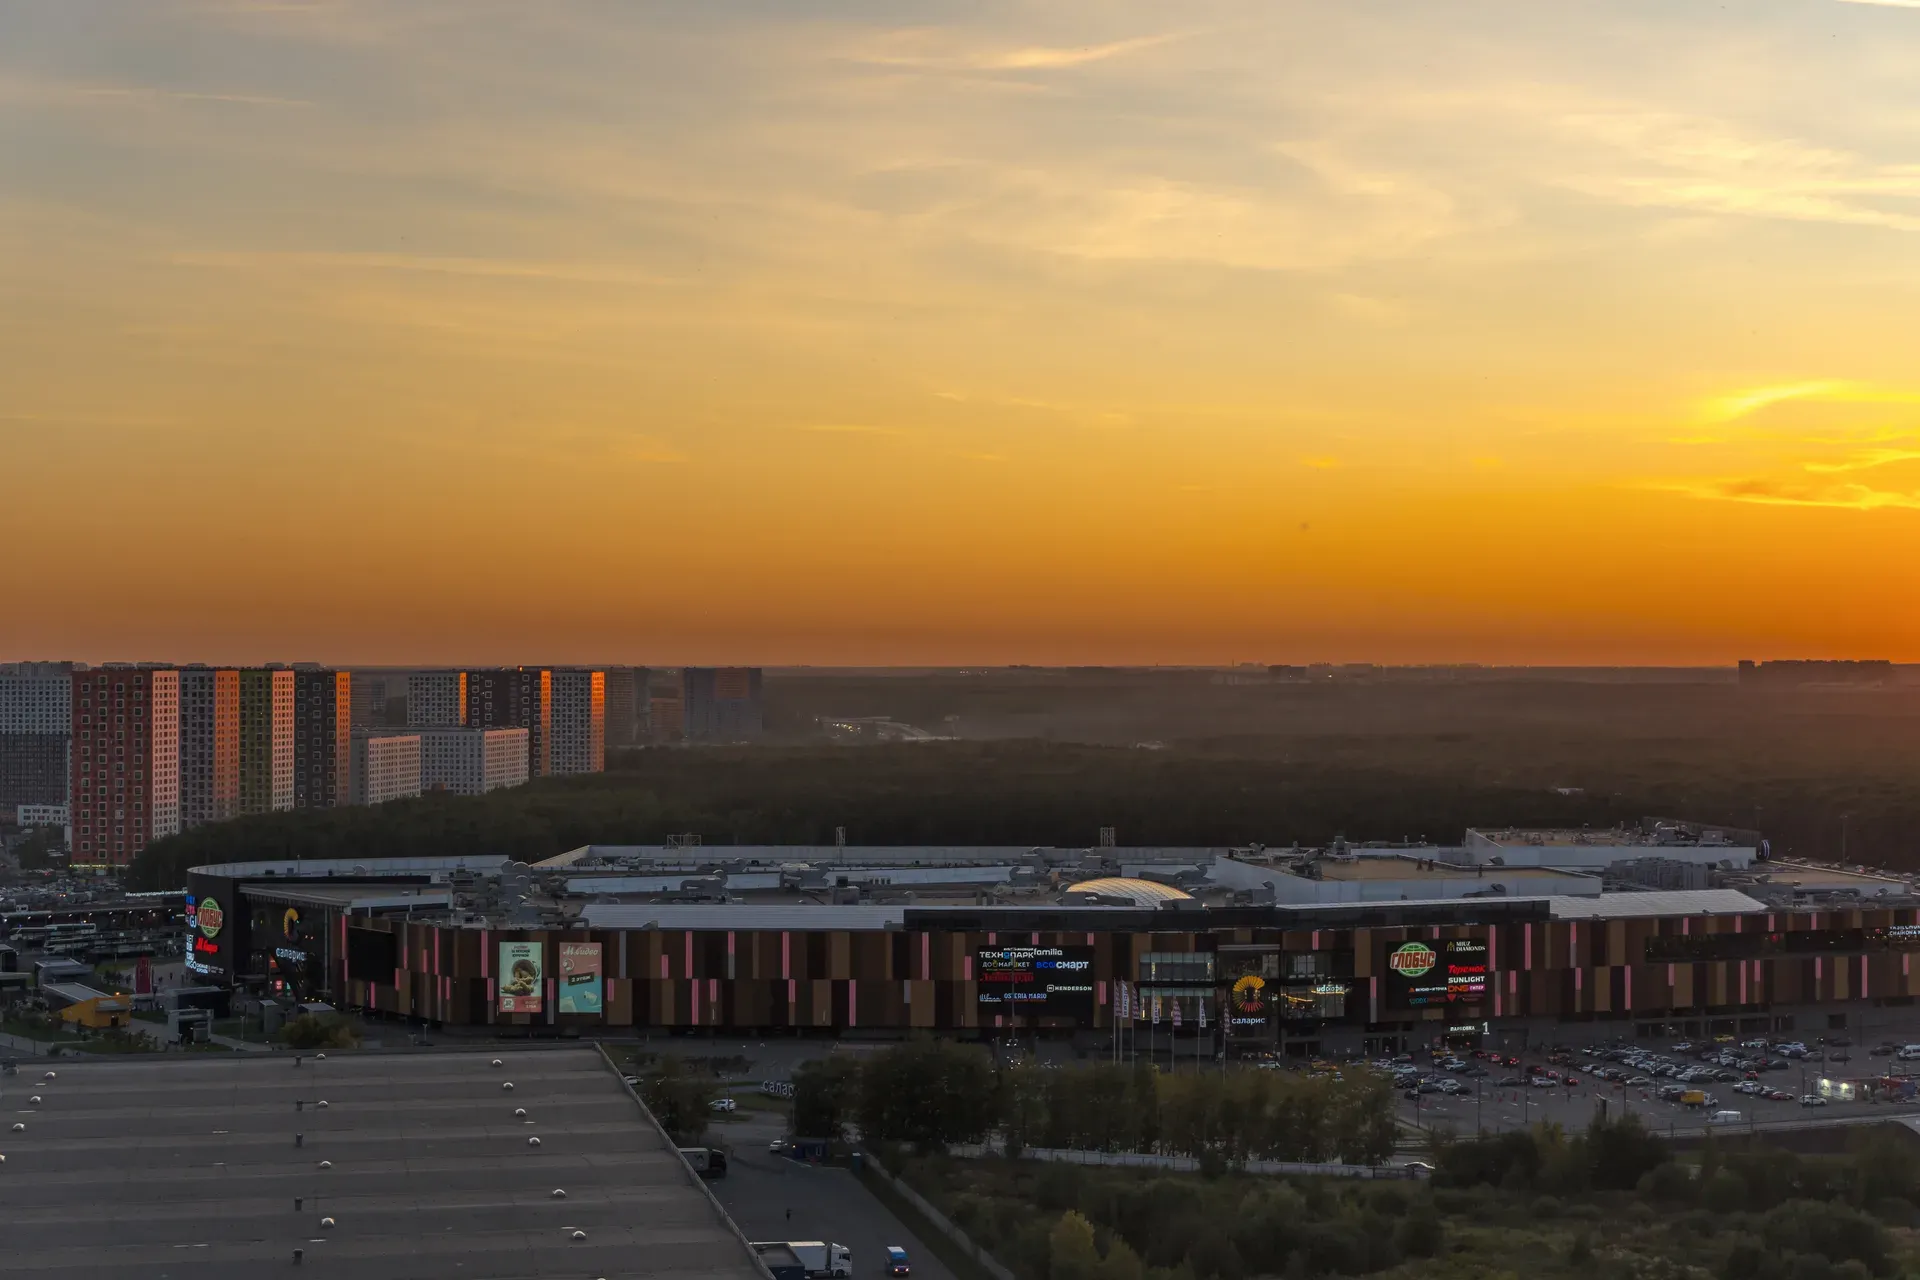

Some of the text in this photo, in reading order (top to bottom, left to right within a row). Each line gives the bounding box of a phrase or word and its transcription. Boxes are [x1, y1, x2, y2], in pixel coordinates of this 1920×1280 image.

[1390, 951, 1436, 969] ГЛОБУС
[1448, 976, 1485, 984] SUNLIGHT
[1448, 985, 1469, 993] DNS
[1231, 1017, 1265, 1026] саларис
[762, 1080, 795, 1097] салар
